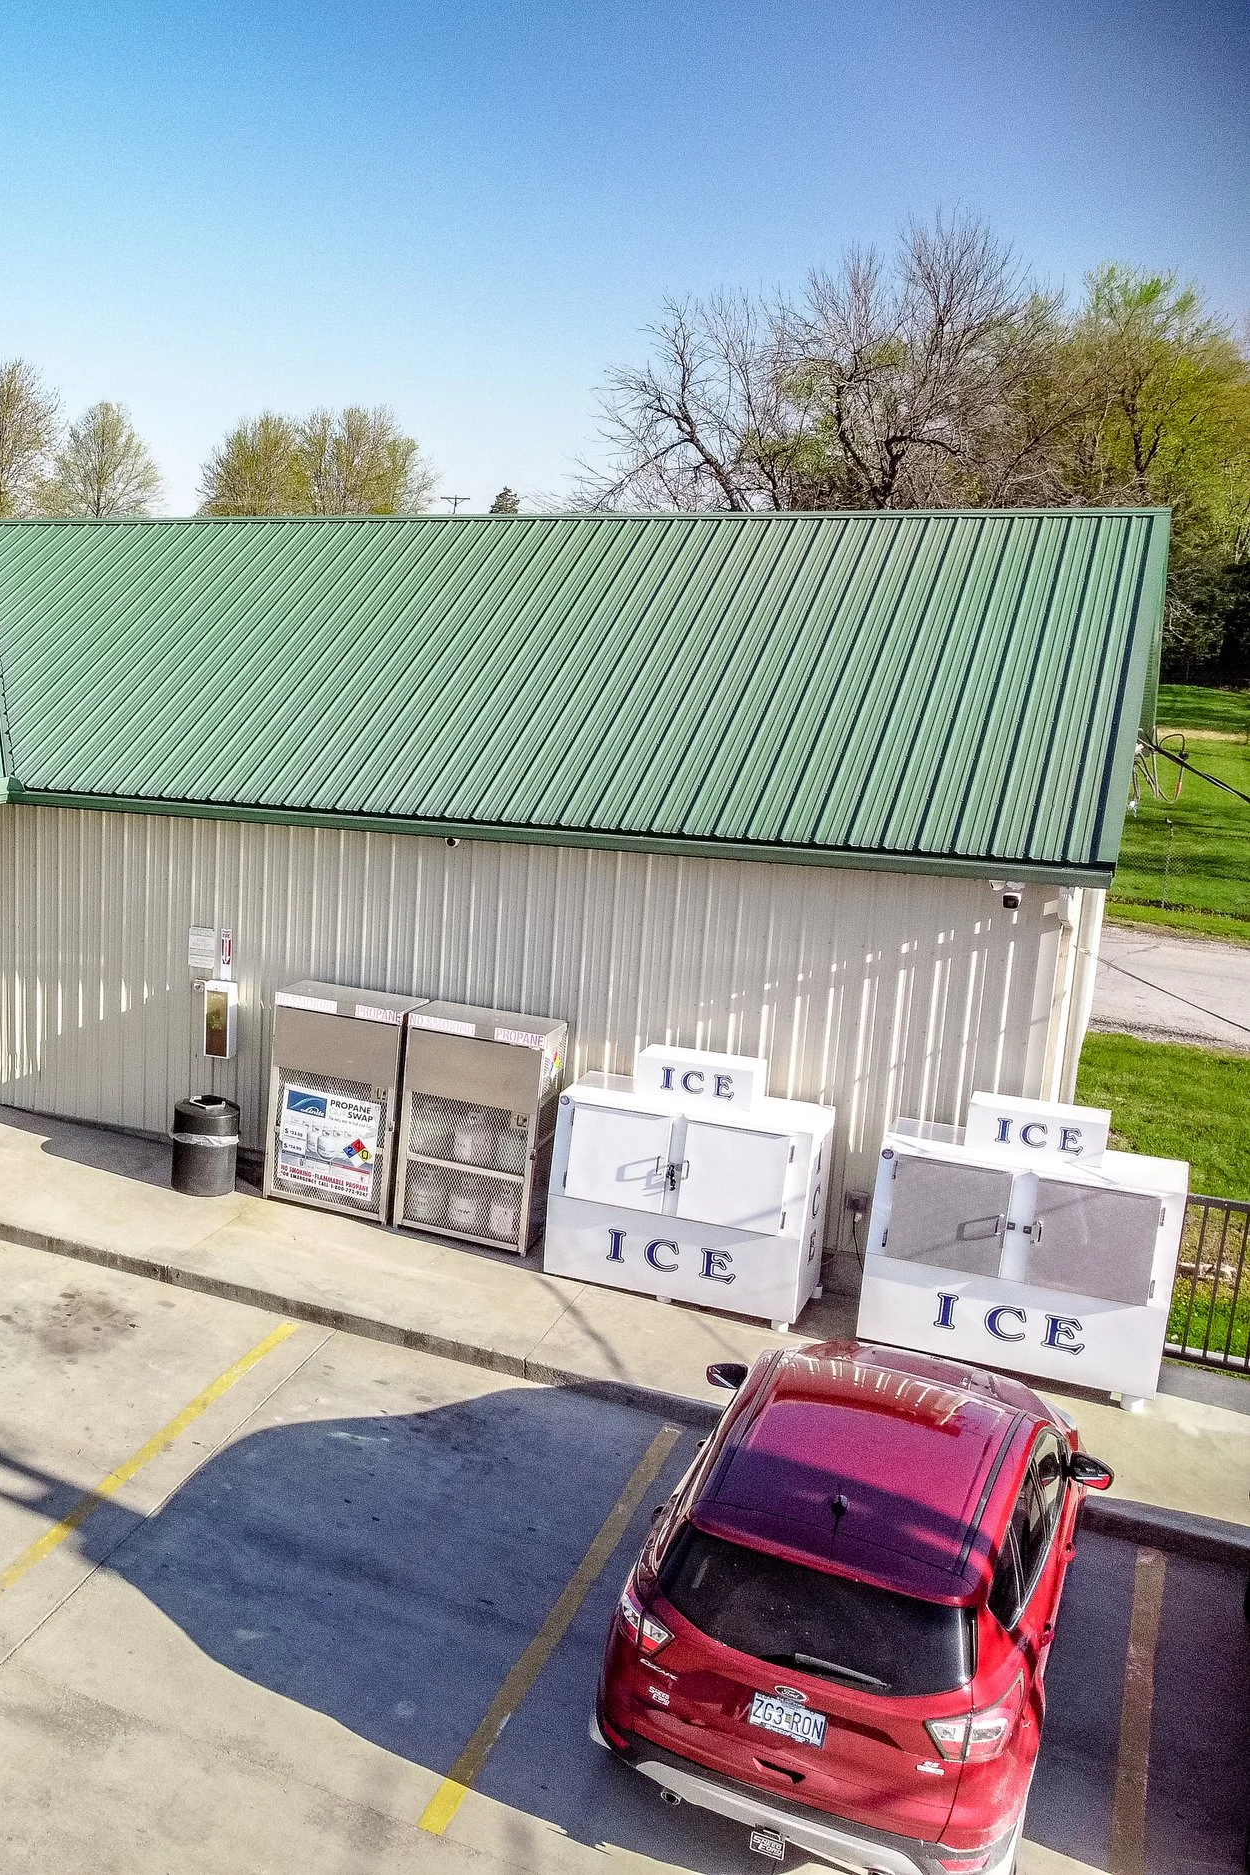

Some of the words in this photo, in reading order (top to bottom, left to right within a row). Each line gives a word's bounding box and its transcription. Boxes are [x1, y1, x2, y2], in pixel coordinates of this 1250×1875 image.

[276, 992, 289, 1004] NO
[291, 995, 336, 1011] SMOKING
[356, 1005, 401, 1024] PROPANE
[409, 1014, 424, 1026] NO
[426, 1017, 474, 1036] SMOKING
[496, 1027, 544, 1047] PROPANE
[660, 1066, 735, 1100] ICE
[330, 1100, 372, 1115] PROPANE
[348, 1111, 374, 1123] SWAP
[994, 1117, 1084, 1156] ICE
[280, 1164, 288, 1172] NO
[289, 1166, 312, 1178] SMOKING
[314, 1173, 344, 1187] FLAMMABLE
[346, 1180, 369, 1192] PROPANE
[290, 1173, 317, 1184] EMERGENCY
[318, 1180, 329, 1188] CALL
[606, 1228, 736, 1285] ICE
[933, 1292, 1085, 1355] ICE
[753, 1698, 784, 1725] ZG3
